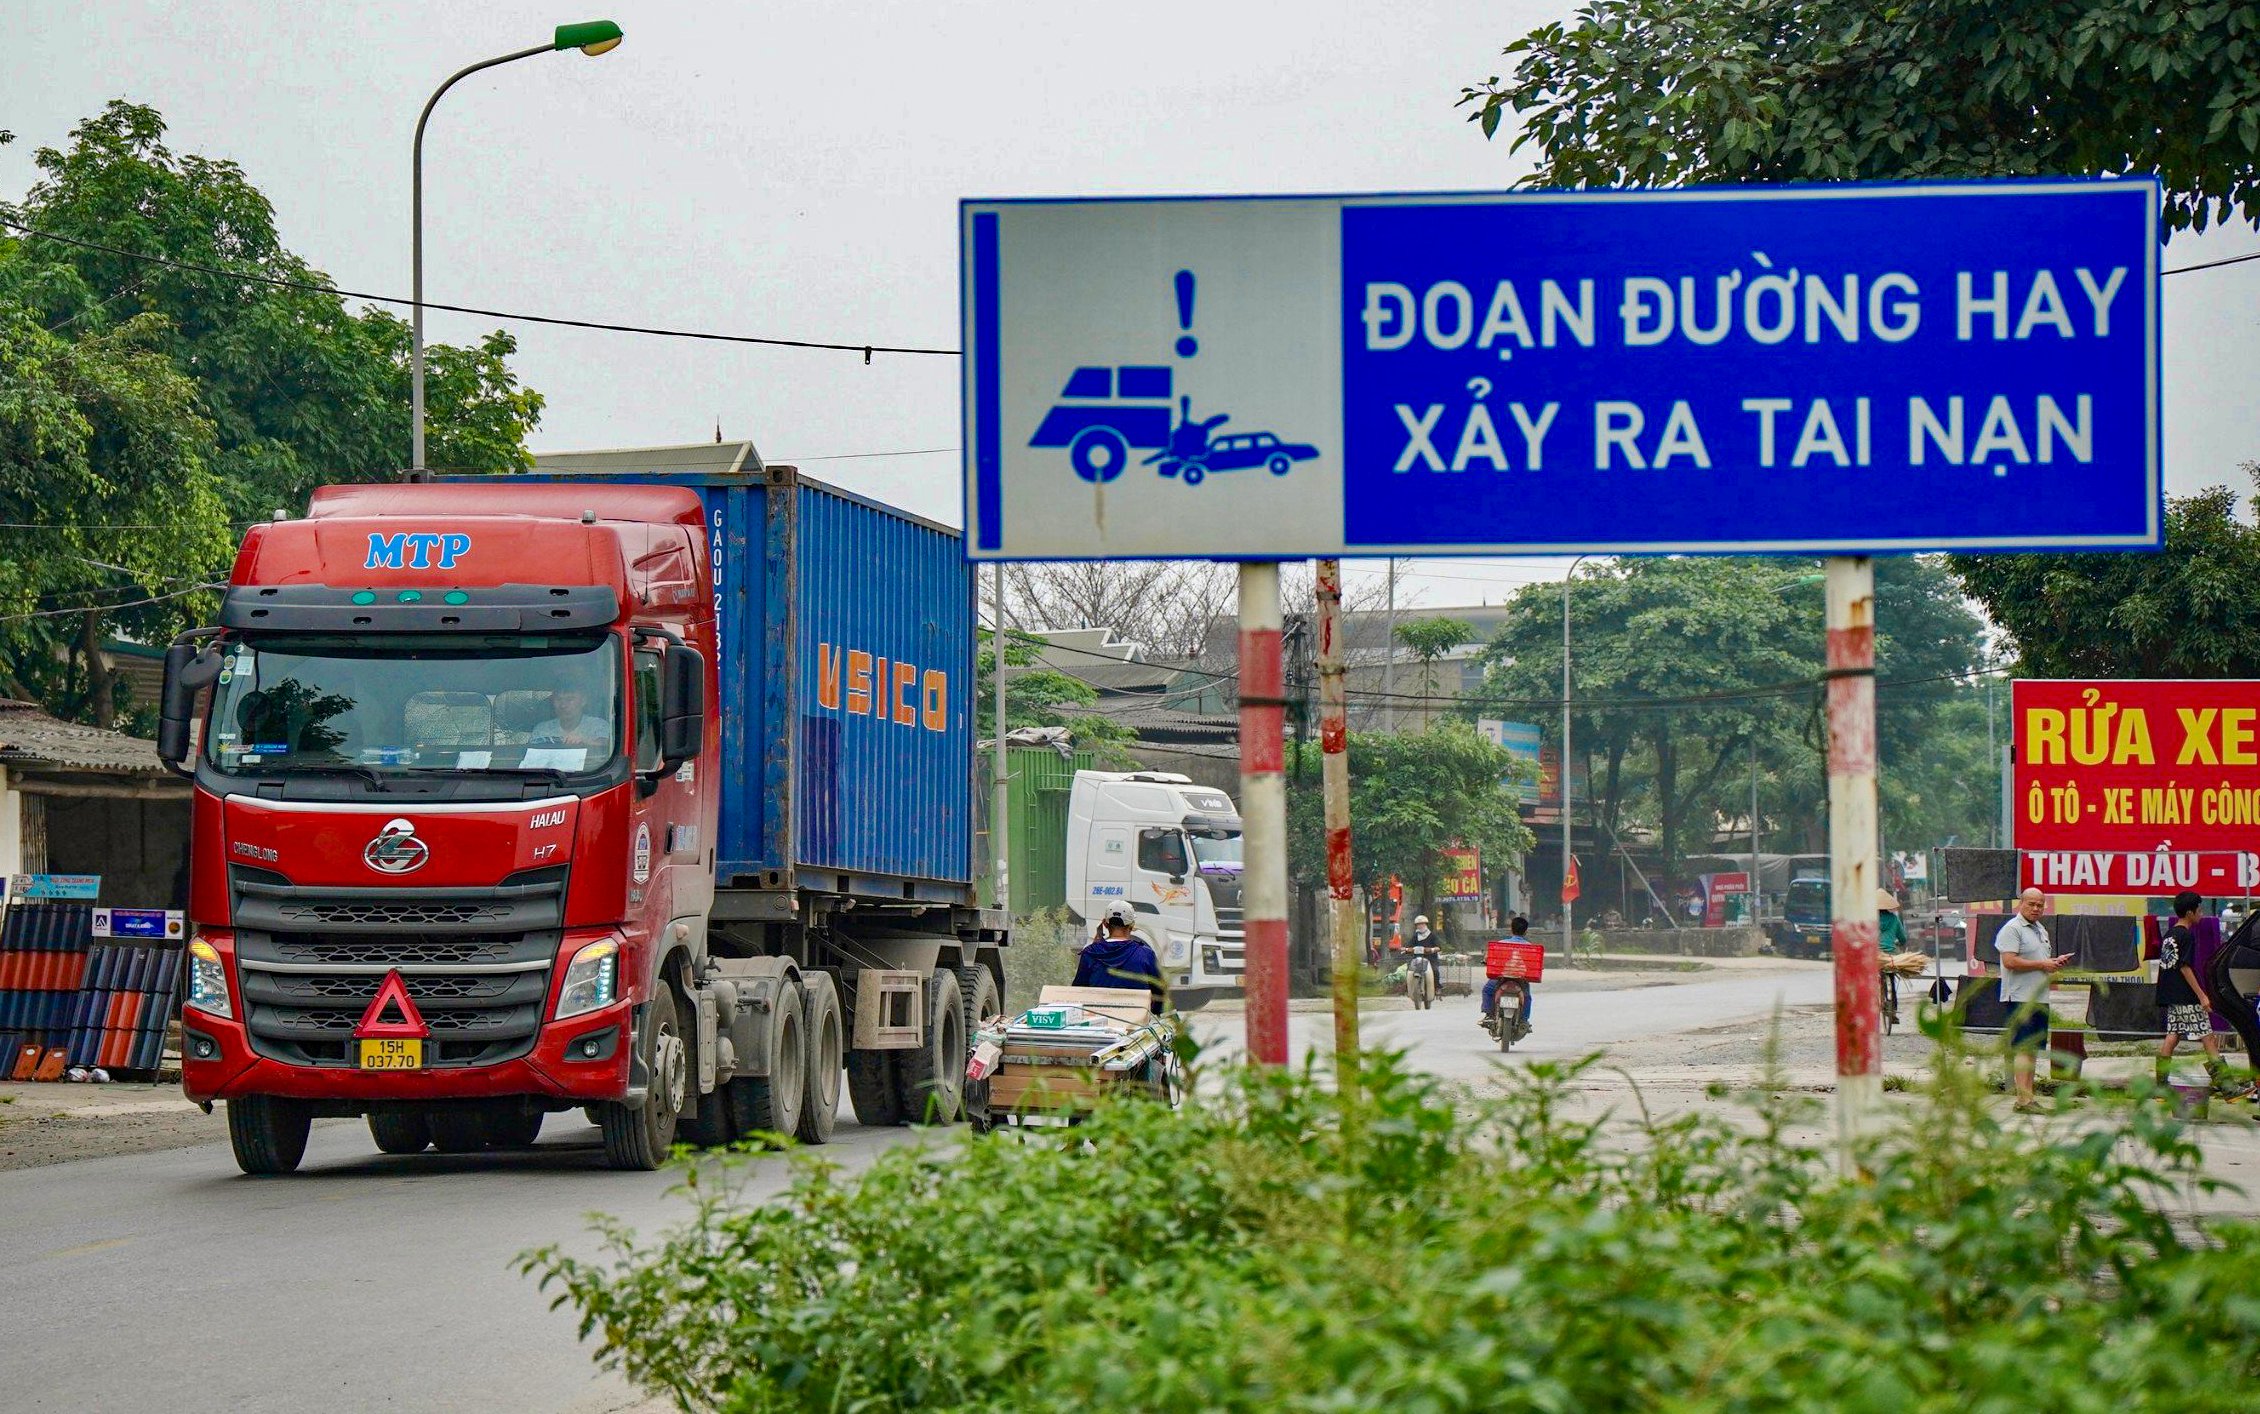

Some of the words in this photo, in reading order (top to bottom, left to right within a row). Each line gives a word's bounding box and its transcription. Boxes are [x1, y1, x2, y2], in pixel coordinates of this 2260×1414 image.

[1362, 279, 1595, 360] ĐOẠN
[1619, 251, 1921, 345] ĐƯỜNG
[1957, 267, 2128, 341] HAY
[1393, 377, 1560, 472] XẢY
[1595, 401, 1712, 469] RA
[1742, 397, 1871, 467] TAI
[1909, 394, 2093, 477] NẠN
[363, 533, 471, 569] MTP
[713, 510, 723, 586] GAOU
[2026, 688, 2156, 765] RỬA
[2175, 708, 2258, 765] XE
[2028, 779, 2044, 824] Ô
[2051, 780, 2080, 824] TÔ
[2103, 788, 2134, 824] XE
[2141, 780, 2194, 825] MÁY
[533, 844, 557, 859] H7
[2028, 852, 2114, 886] THAY
[2126, 839, 2199, 887] DẦU
[1032, 1015, 1055, 1024] ASIA
[367, 1055, 415, 1068] 037.70
[380, 1041, 404, 1053] 15H
